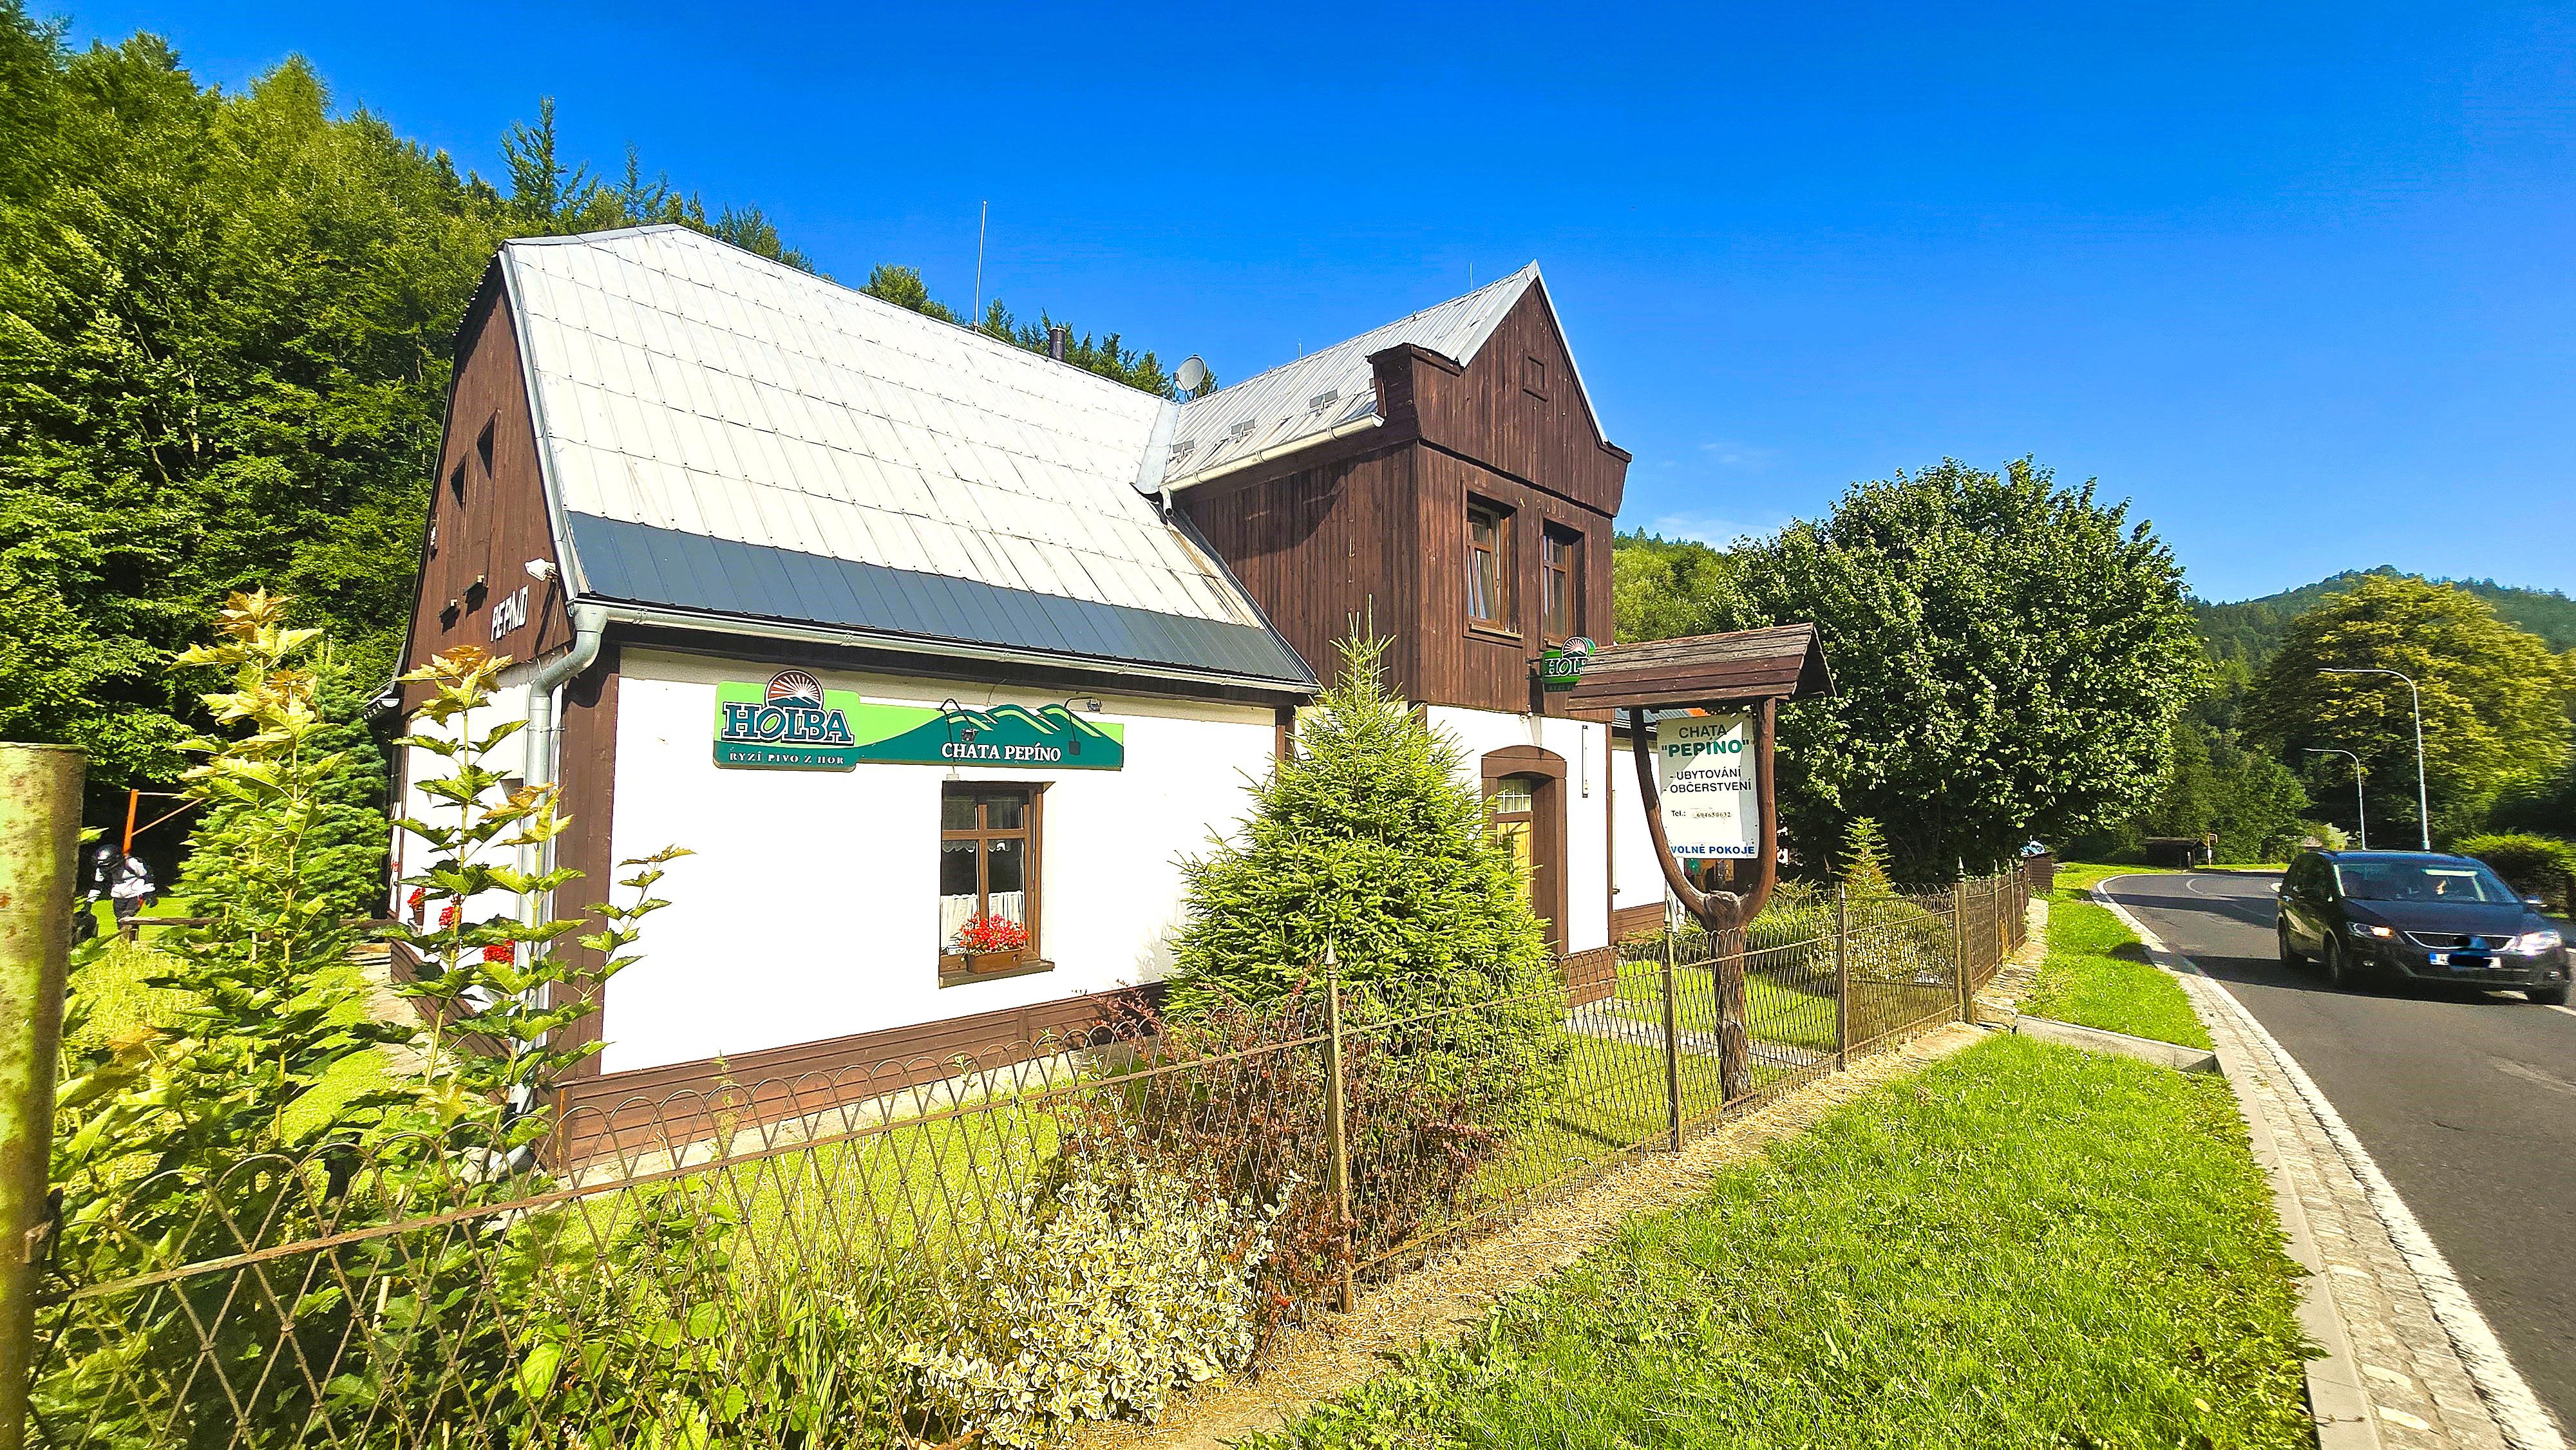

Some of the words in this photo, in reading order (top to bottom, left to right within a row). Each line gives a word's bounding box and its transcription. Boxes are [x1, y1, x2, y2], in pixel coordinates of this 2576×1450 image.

[721, 702, 855, 746] HOLBA
[1678, 724, 1727, 739] CHATA
[729, 750, 762, 762] RYZÍ
[768, 754, 799, 763] PIVO
[804, 755, 812, 764] Z
[817, 756, 844, 764] HOR
[942, 742, 1001, 759] CHATA
[1004, 742, 1061, 762] PEPÍNO
[1676, 766, 1741, 780] UBYTOVÁNÍ
[1670, 778, 1752, 793] OBČERSTVENÍ
[1671, 843, 1705, 854] VOLNÉ
[1709, 846, 1756, 854] POKOJE
